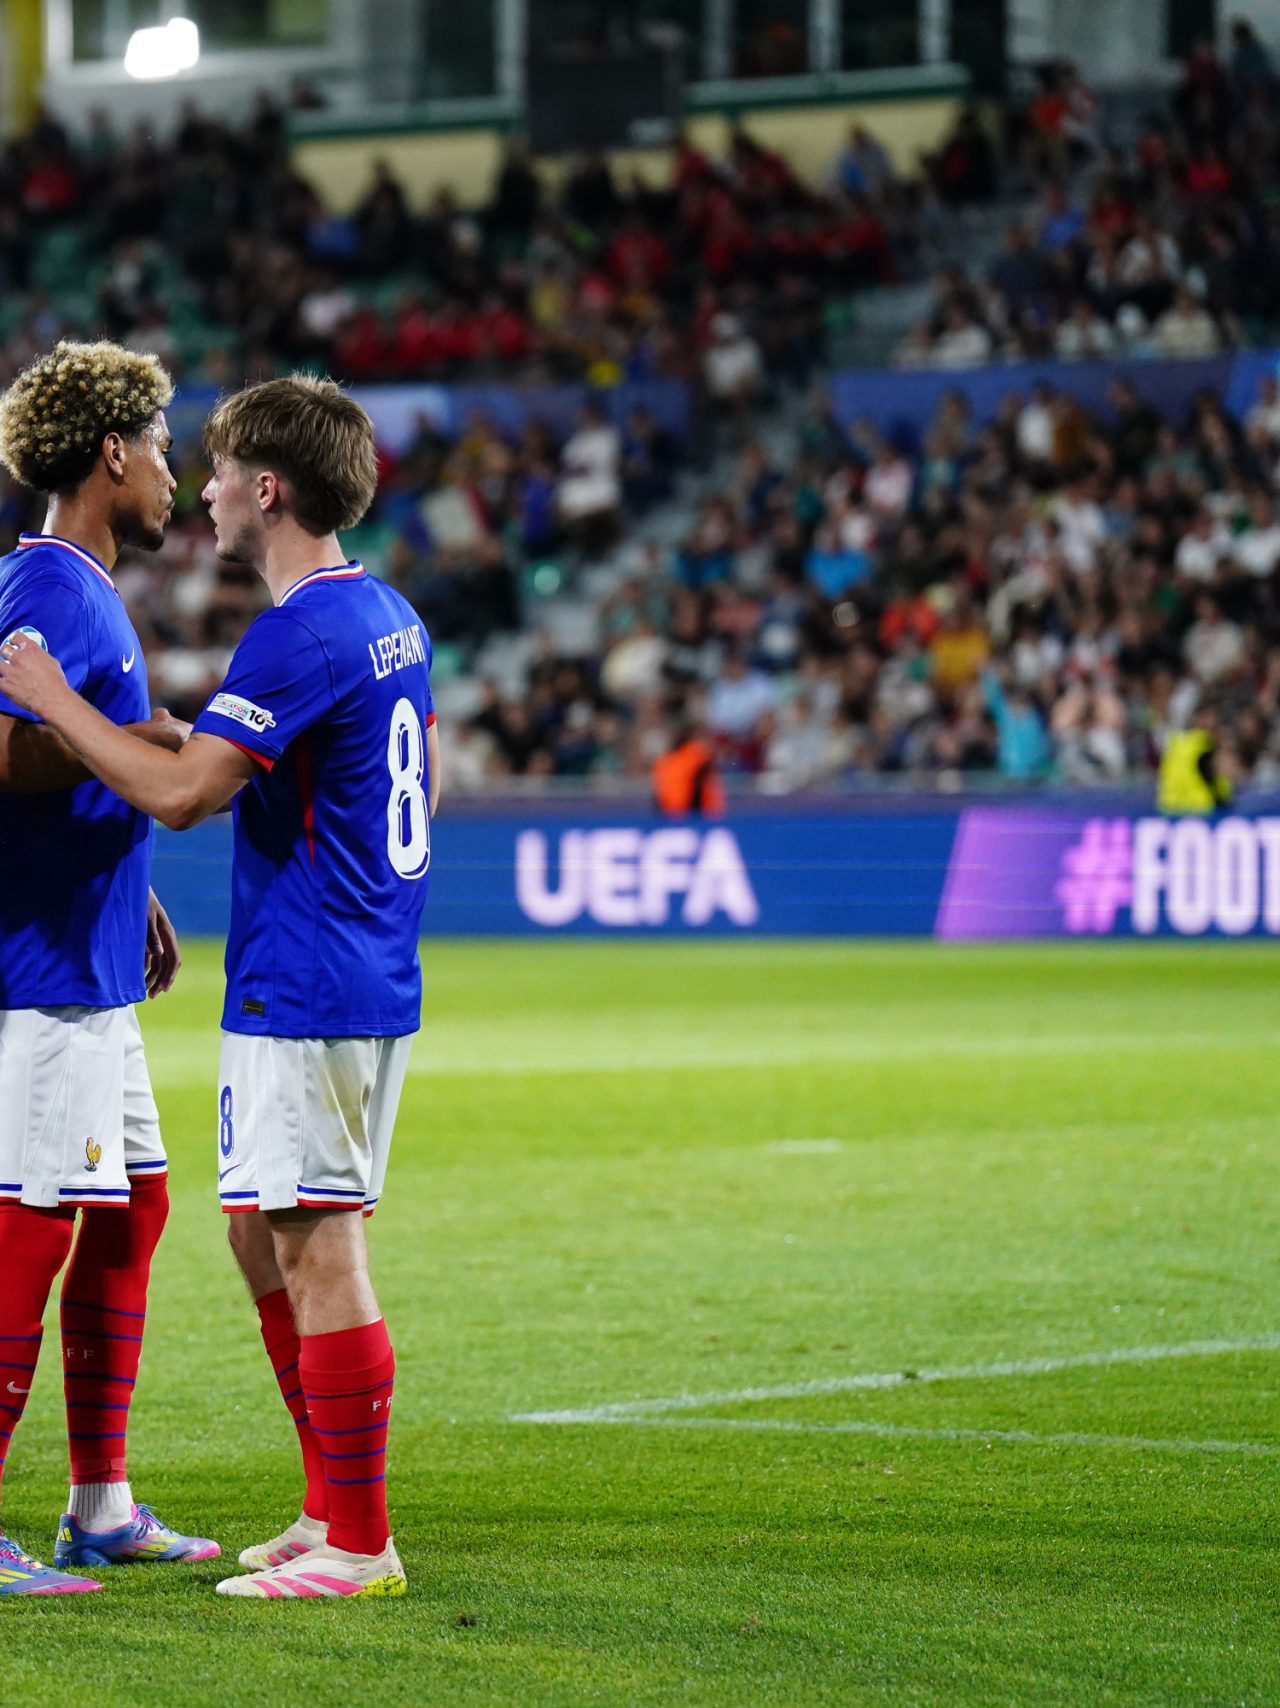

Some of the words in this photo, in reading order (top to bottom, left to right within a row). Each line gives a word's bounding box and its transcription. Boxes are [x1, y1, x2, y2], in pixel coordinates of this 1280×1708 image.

[368, 624, 425, 681] LEPENANT
[387, 697, 431, 880] 8
[515, 827, 760, 926] UEFA
[220, 1085, 234, 1159] 8
